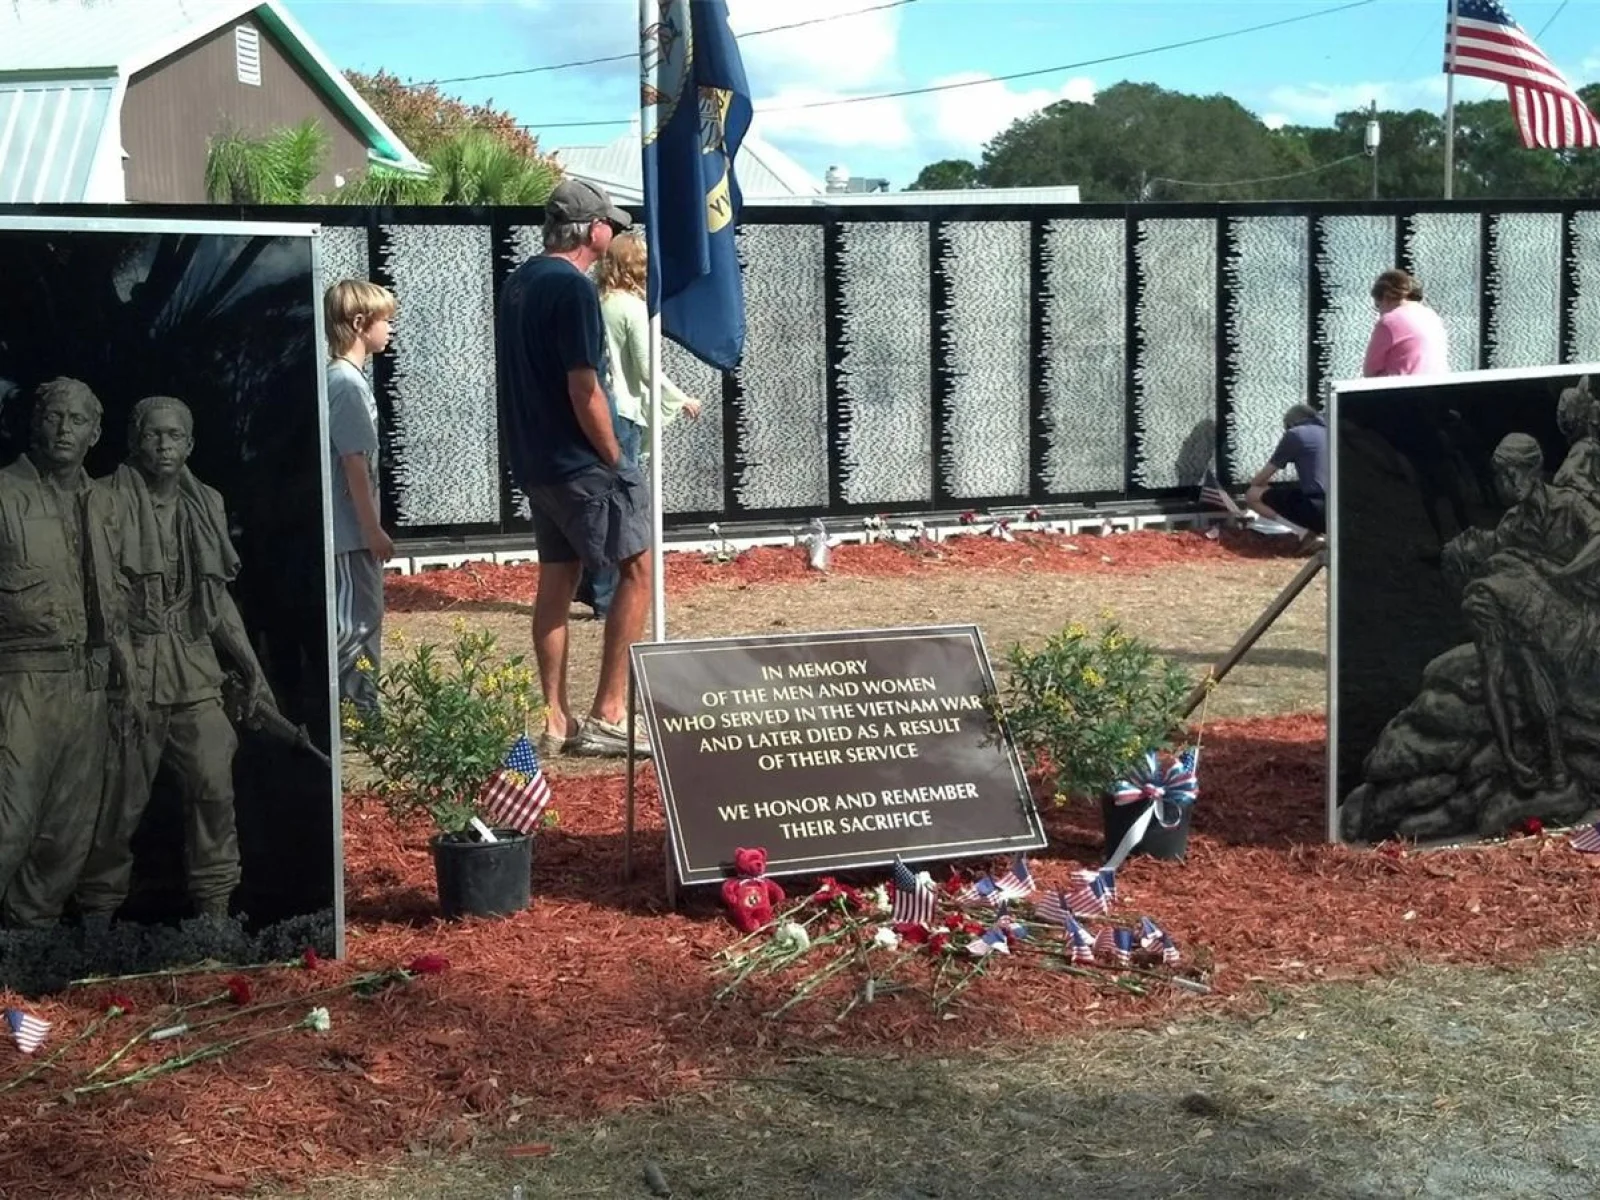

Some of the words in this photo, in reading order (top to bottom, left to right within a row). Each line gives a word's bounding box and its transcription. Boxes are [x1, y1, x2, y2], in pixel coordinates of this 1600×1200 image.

[761, 665, 783, 680] IN
[788, 659, 867, 678] MEMORY
[701, 691, 727, 707] OF
[730, 688, 767, 704] THE
[773, 685, 814, 701] MEN
[818, 681, 860, 698] AND
[861, 677, 936, 695] WOMEN
[662, 714, 716, 733] WHO
[720, 709, 790, 728] SERVED
[794, 707, 816, 722] IN
[817, 703, 855, 720] THE
[855, 698, 939, 717] VIETNAM
[939, 695, 983, 711] WAR
[699, 735, 743, 753] AND
[747, 730, 803, 749] LATER
[806, 726, 853, 744] DIED
[857, 723, 879, 739] AS
[883, 722, 897, 738] A
[898, 717, 960, 736] RESULT
[758, 753, 785, 771] OF
[786, 749, 843, 768] THEIR
[845, 742, 919, 763] SERVICE
[717, 803, 751, 822] WE
[753, 796, 831, 819] HONOR
[834, 791, 877, 810] AND
[881, 782, 979, 806] REMEMBER
[778, 819, 837, 840] THEIR
[839, 809, 933, 834] SACRIFICE
